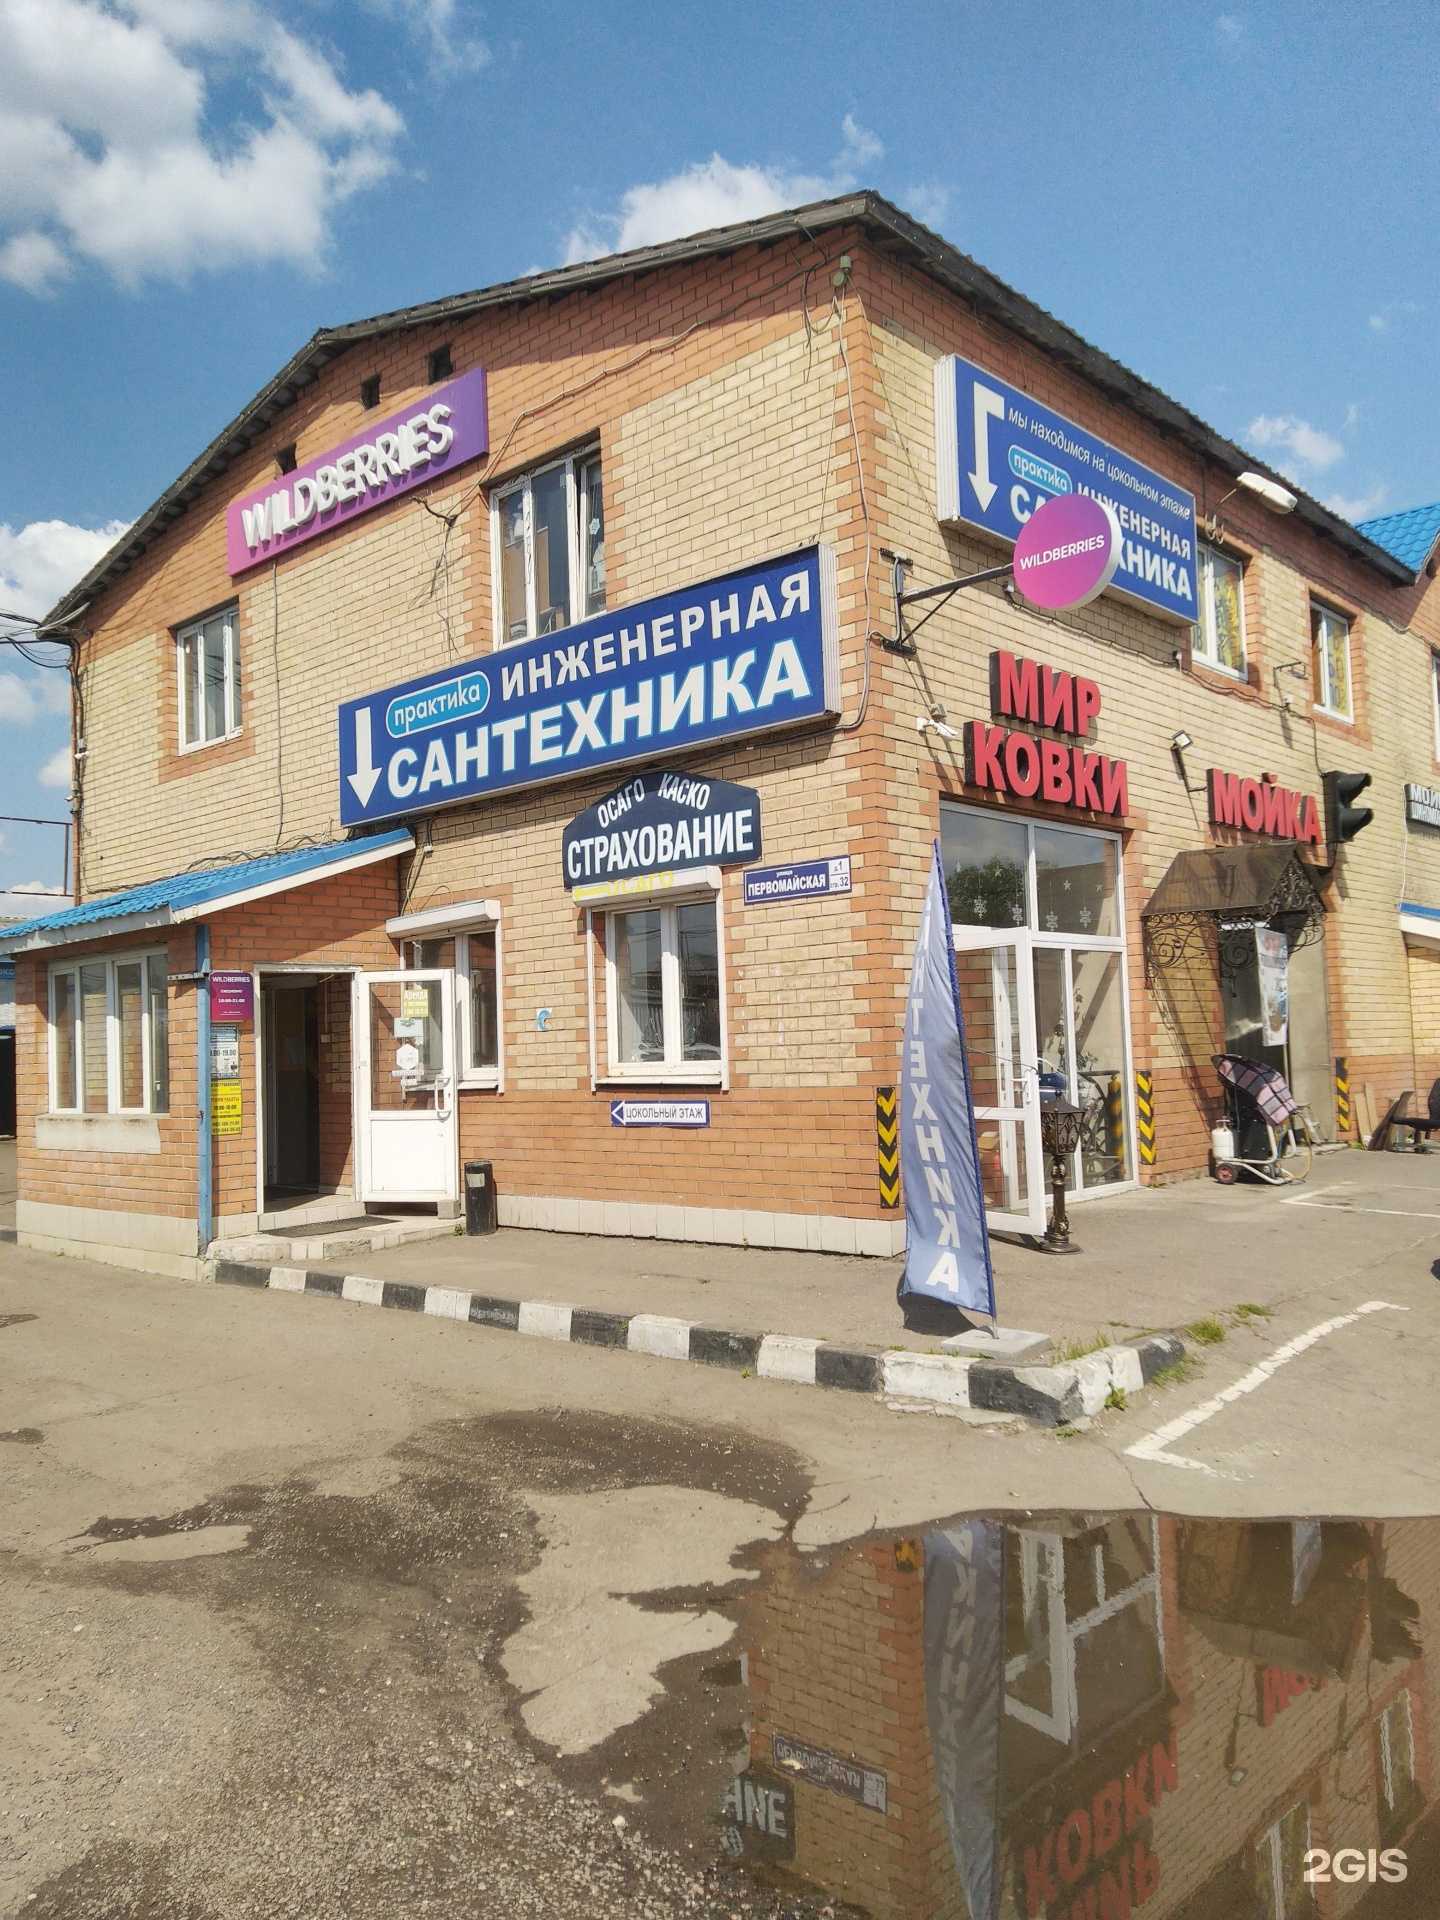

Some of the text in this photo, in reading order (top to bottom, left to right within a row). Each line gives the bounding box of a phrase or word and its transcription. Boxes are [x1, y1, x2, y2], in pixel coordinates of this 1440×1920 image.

[240, 402, 454, 550] WILDBERRIES
[1013, 453, 1068, 492] практика
[1030, 417, 1090, 464] находимся
[1092, 455, 1105, 473] на
[1108, 462, 1159, 503] цокольном
[1160, 493, 1191, 521] этаже
[1020, 534, 1105, 570] WILDBERRIES
[393, 569, 811, 729] практика ИНЖЕНЕРНАЯ
[387, 638, 813, 798] САНТЕХНИКА
[993, 650, 1101, 738] МИР
[597, 773, 711, 828] ОСАГО КАСКО
[967, 721, 1129, 818] КОВКИ
[1208, 768, 1324, 846] МОЙКА
[567, 809, 754, 880] СТРАХОВАНИЕ
[747, 873, 826, 897] ПЕРВОМАЙСКАЯ
[626, 1105, 703, 1119] ЦОКОЛЬНЫЙ ЭТАЖ
